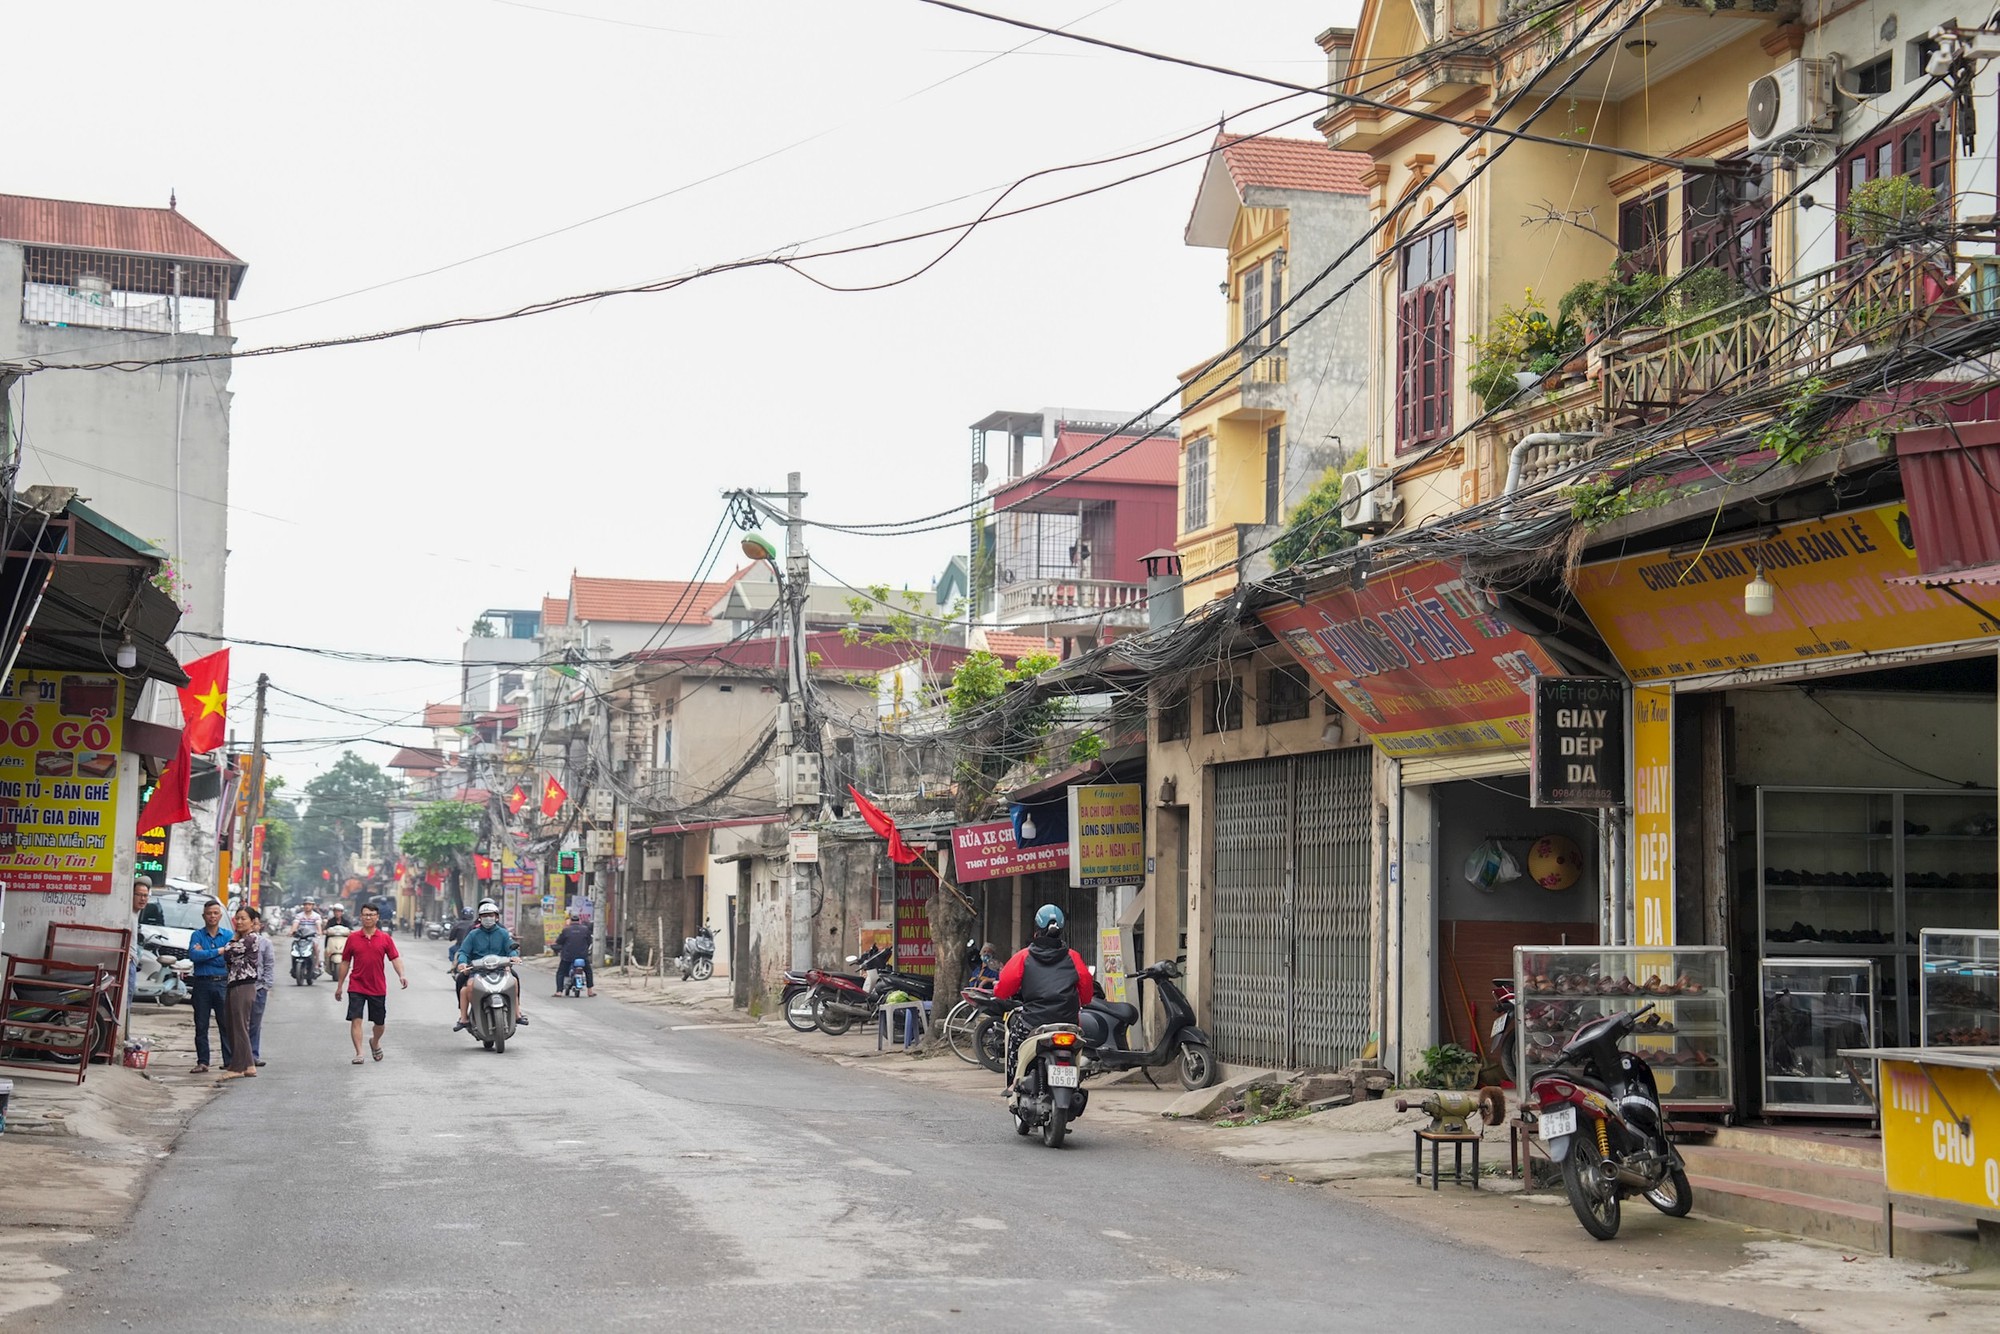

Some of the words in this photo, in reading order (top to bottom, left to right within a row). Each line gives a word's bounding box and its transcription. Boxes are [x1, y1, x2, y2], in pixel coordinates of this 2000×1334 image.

[1841, 517, 1877, 554] LẺ
[1316, 611, 1410, 678] HÙNG
[1377, 586, 1475, 664] PHÁT
[1483, 678, 1514, 698] TIN
[1545, 685, 1574, 703] VIỆT
[1577, 685, 1620, 700] HOÀN
[1556, 704, 1607, 728] GIÀY
[52, 708, 111, 751] GỖ
[1560, 732, 1604, 756] DÉP
[1567, 764, 1597, 783] DA
[25, 777, 41, 798] TỦ
[54, 781, 80, 800] BÀN
[85, 782, 111, 800] GHẾ
[1637, 757, 1668, 814] GIÀY
[8, 803, 39, 824] THẤT
[43, 809, 64, 824] GIA
[68, 807, 99, 826] ĐÌNH
[15, 832, 31, 849] Tại
[34, 833, 56, 847] Nhà
[59, 831, 84, 848] Miễn
[86, 834, 106, 849] Phí
[959, 829, 982, 848] RỬA
[982, 830, 997, 844] XE
[965, 858, 988, 869] THAY
[1016, 852, 1036, 862] DỌN
[1038, 849, 1054, 860] NỘI
[1641, 823, 1668, 881] DÉP
[914, 873, 937, 900] CHỮA
[898, 904, 915, 919] MÁY
[1644, 897, 1663, 946] DA
[901, 922, 920, 939] MÁY
[898, 943, 919, 957] CUNG
[1890, 1070, 1930, 1124] THỊT
